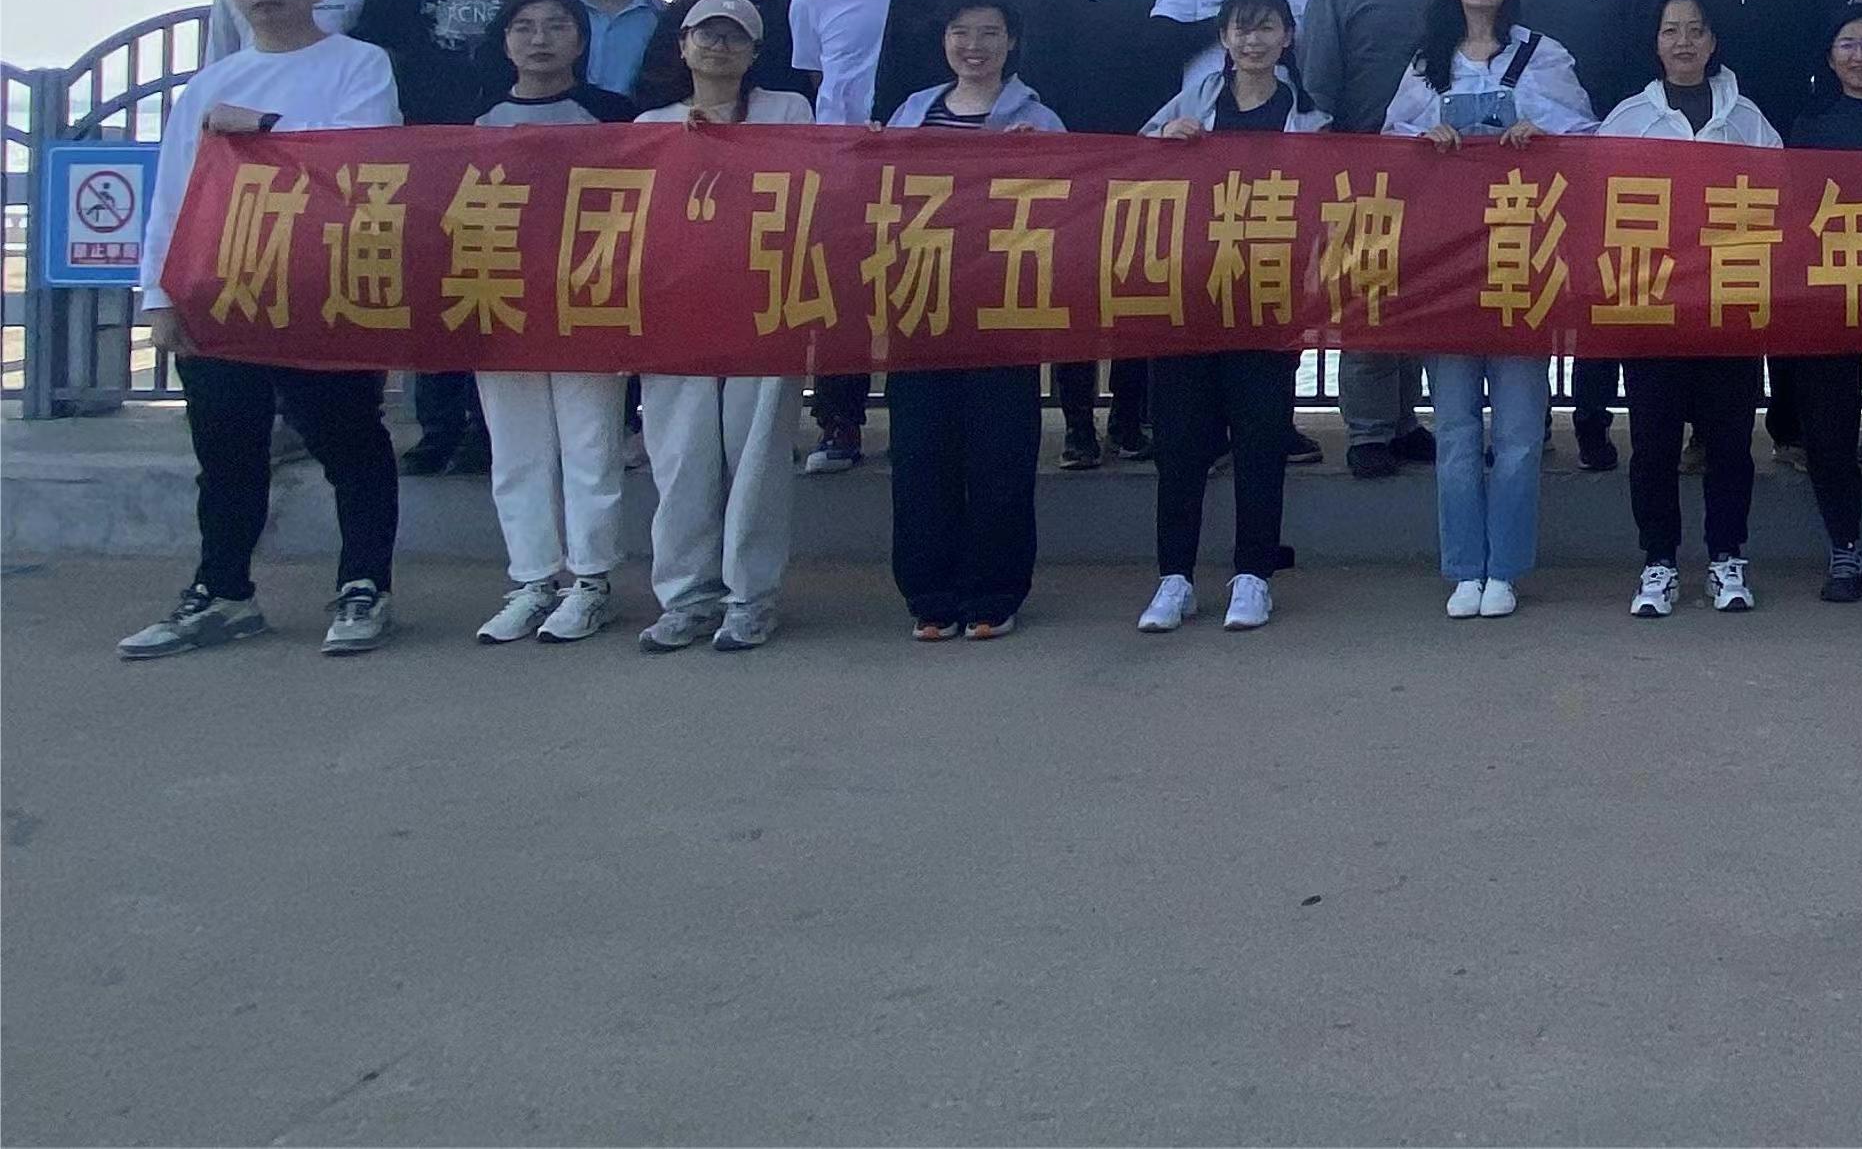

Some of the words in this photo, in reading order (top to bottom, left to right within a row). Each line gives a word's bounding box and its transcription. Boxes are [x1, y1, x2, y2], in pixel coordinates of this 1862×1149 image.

[209, 163, 1405, 337] 财通集团“弘扬五四精神
